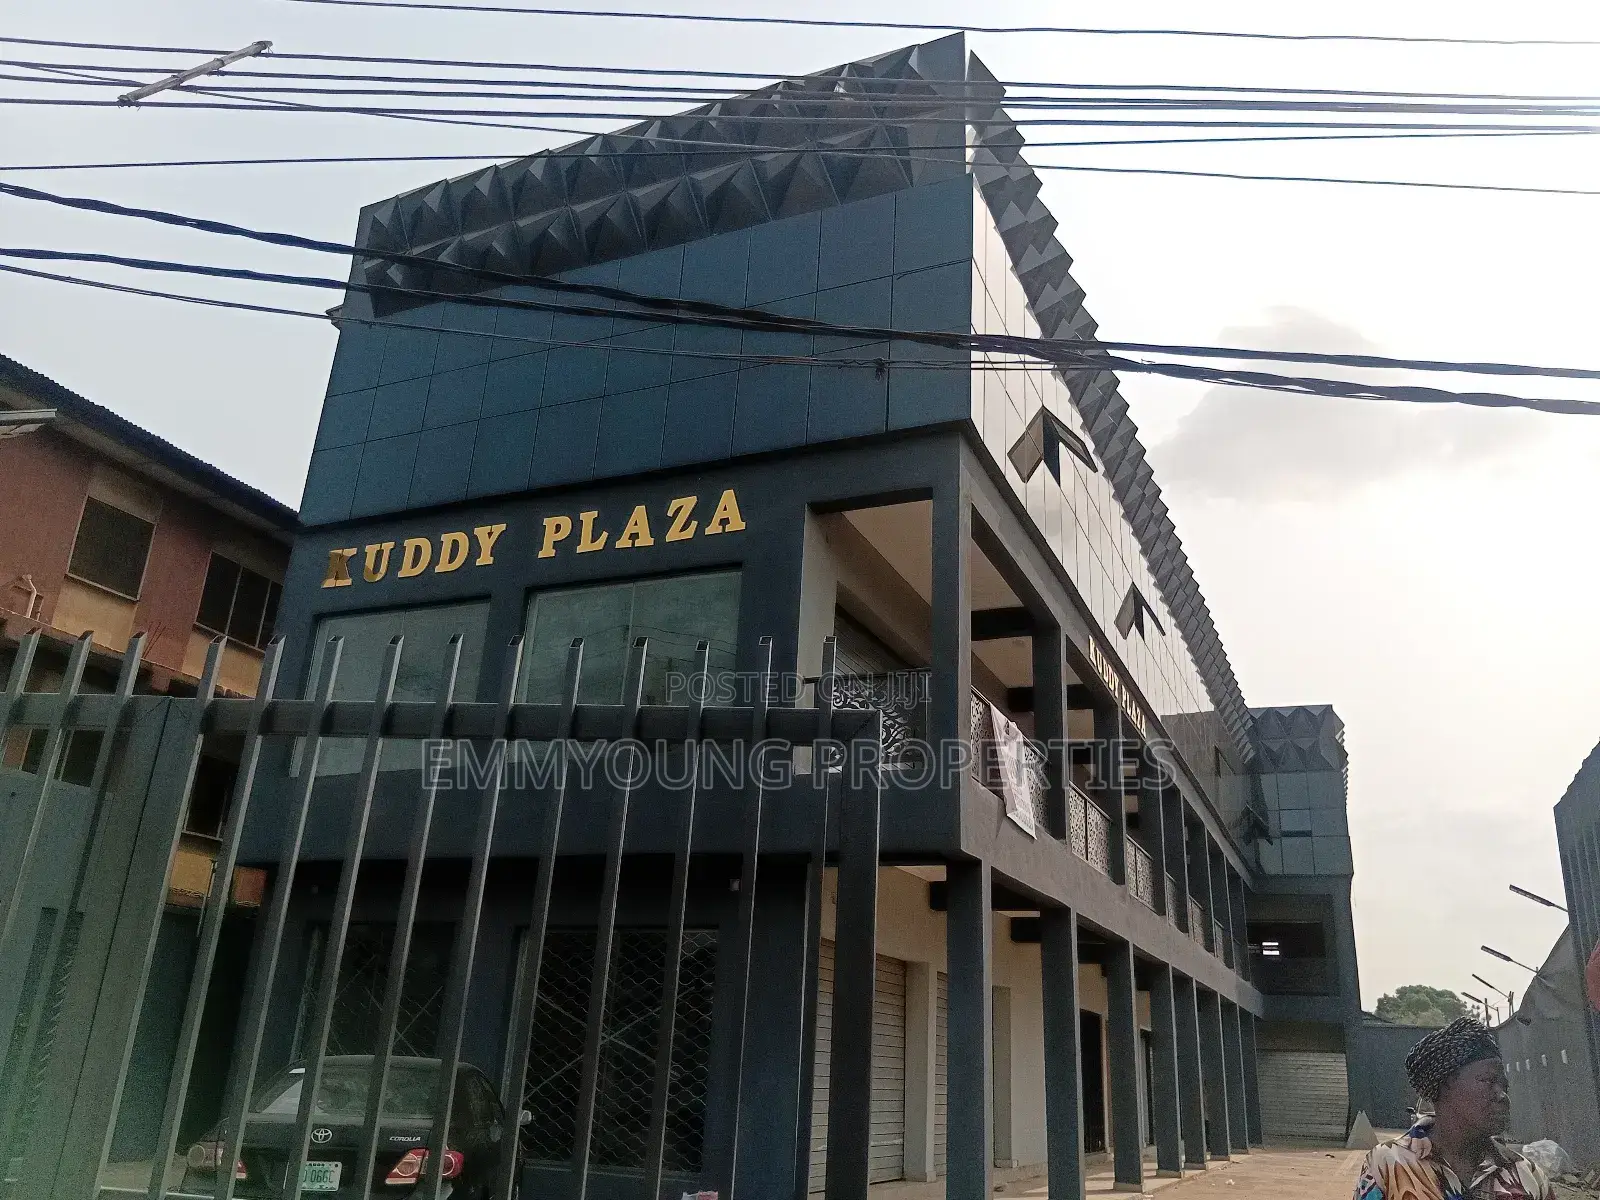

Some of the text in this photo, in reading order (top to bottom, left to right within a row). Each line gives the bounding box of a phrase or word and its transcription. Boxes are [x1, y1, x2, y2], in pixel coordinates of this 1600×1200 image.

[321, 489, 746, 588] KUDDY PLAZA
[1088, 634, 1147, 739] KUDDY PLAZA
